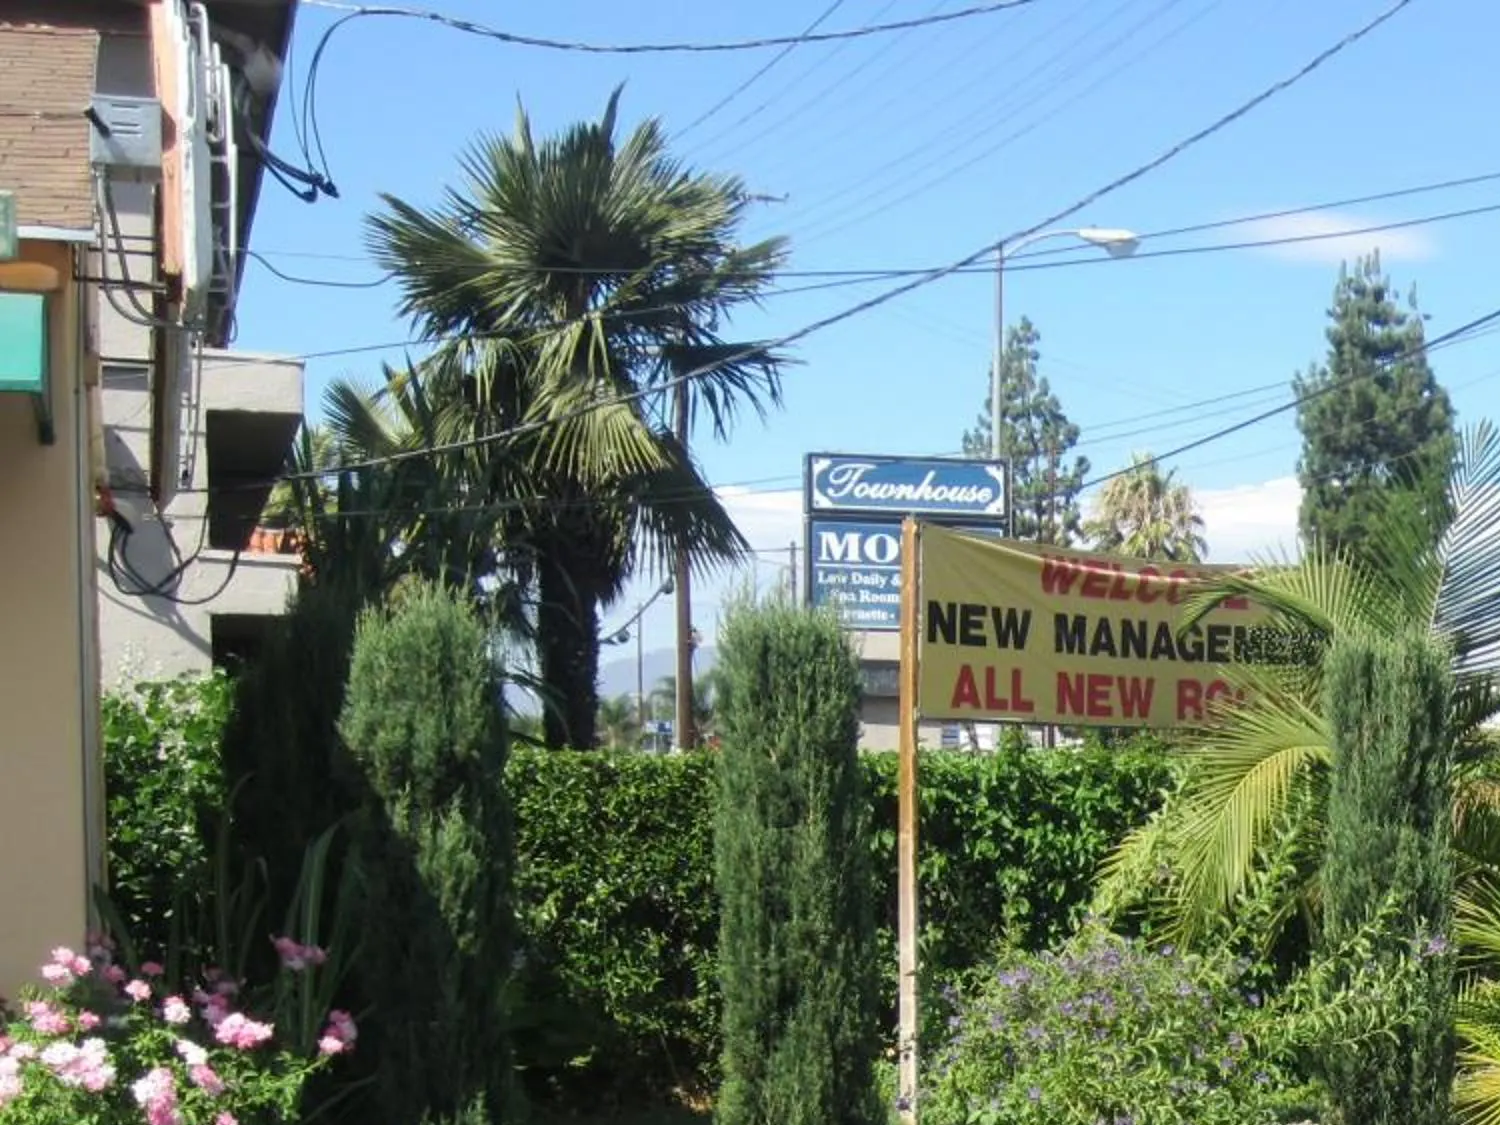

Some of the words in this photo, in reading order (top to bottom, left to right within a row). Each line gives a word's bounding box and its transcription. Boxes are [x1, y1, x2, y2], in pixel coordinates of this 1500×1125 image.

[827, 463, 993, 503] Townhouse
[818, 531, 902, 563] MO
[1040, 555, 1249, 611] WELCO
[927, 601, 1032, 650] NEW
[1054, 613, 1322, 665] MANAGE
[951, 664, 1034, 713] ALL
[1056, 671, 1155, 719] NEW
